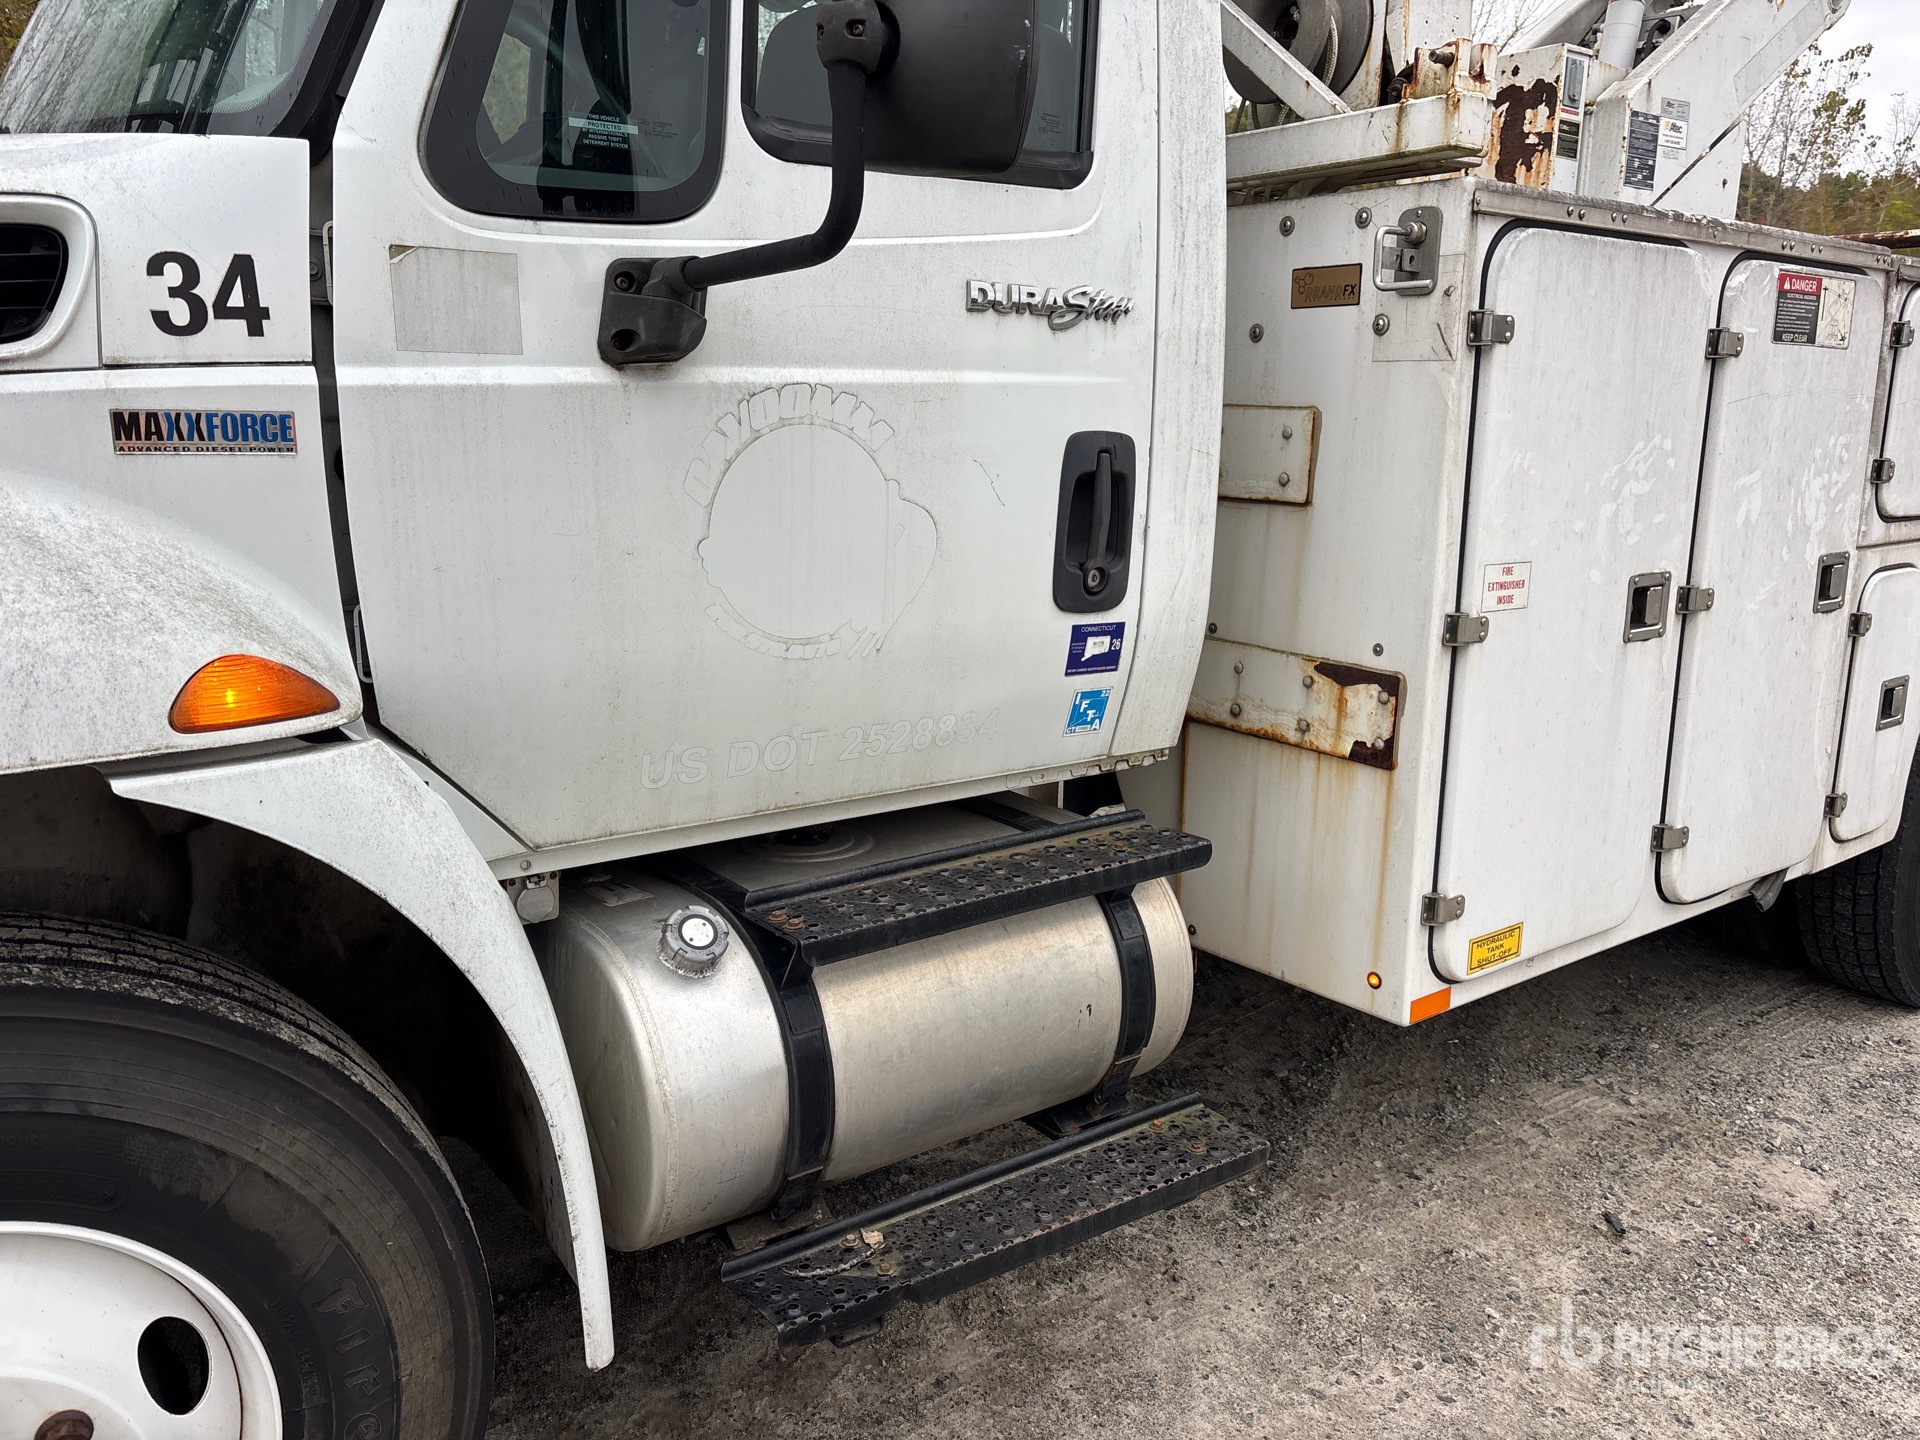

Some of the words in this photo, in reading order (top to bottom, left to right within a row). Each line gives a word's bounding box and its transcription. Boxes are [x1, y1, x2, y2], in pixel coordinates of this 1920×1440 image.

[587, 121, 622, 131] PROTECTED
[610, 141, 629, 149] SYSTEM
[1791, 278, 1817, 292] DANGER
[146, 251, 270, 337] 34
[1782, 333, 1793, 342] KEEP
[1794, 334, 1808, 342] CLEAR
[112, 411, 295, 443] MAXXFORCE
[1502, 566, 1514, 576] FIRE
[1488, 580, 1525, 591] EXTINGUISHER
[1496, 594, 1514, 605] INSIDE
[1111, 639, 1121, 651] 26
[1066, 726, 1076, 734] CT
[640, 747, 710, 789] US
[727, 730, 828, 778] DOT
[1477, 931, 1515, 949] HYDRAULIC
[1487, 943, 1504, 953] TANK
[1477, 948, 1512, 965] SHUT-OFF
